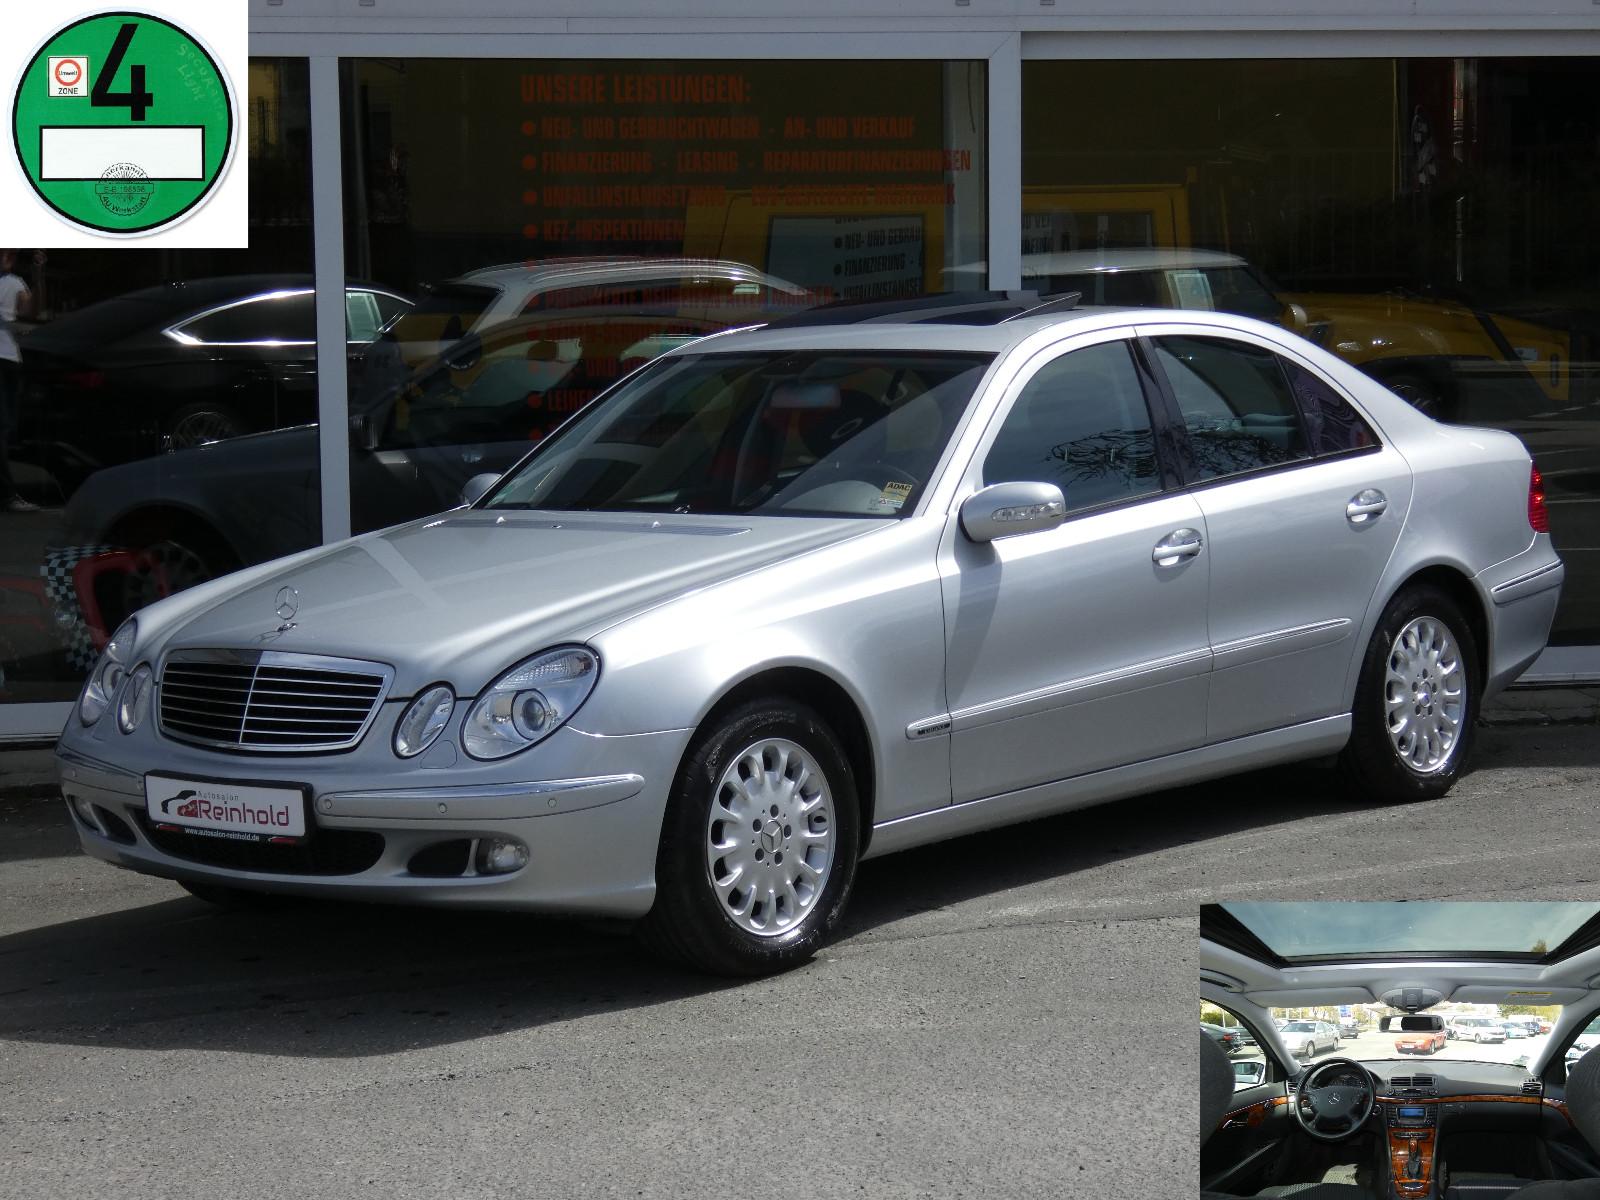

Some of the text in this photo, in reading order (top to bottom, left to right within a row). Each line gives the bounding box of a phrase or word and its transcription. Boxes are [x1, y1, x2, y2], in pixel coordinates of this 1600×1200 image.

[520, 74, 752, 102] UNSERE LEISTUNGEN:
[583, 117, 614, 139] UND
[816, 117, 847, 138] UND
[853, 117, 915, 138] VERKAUF
[541, 151, 653, 173] FINANZIERUNG
[676, 151, 739, 173] LEASING
[887, 482, 911, 491] ADAC
[197, 790, 239, 801] Autosalon
[198, 800, 290, 827] Reinhold
[184, 827, 261, 842] www.autosalon-reinhold.de
